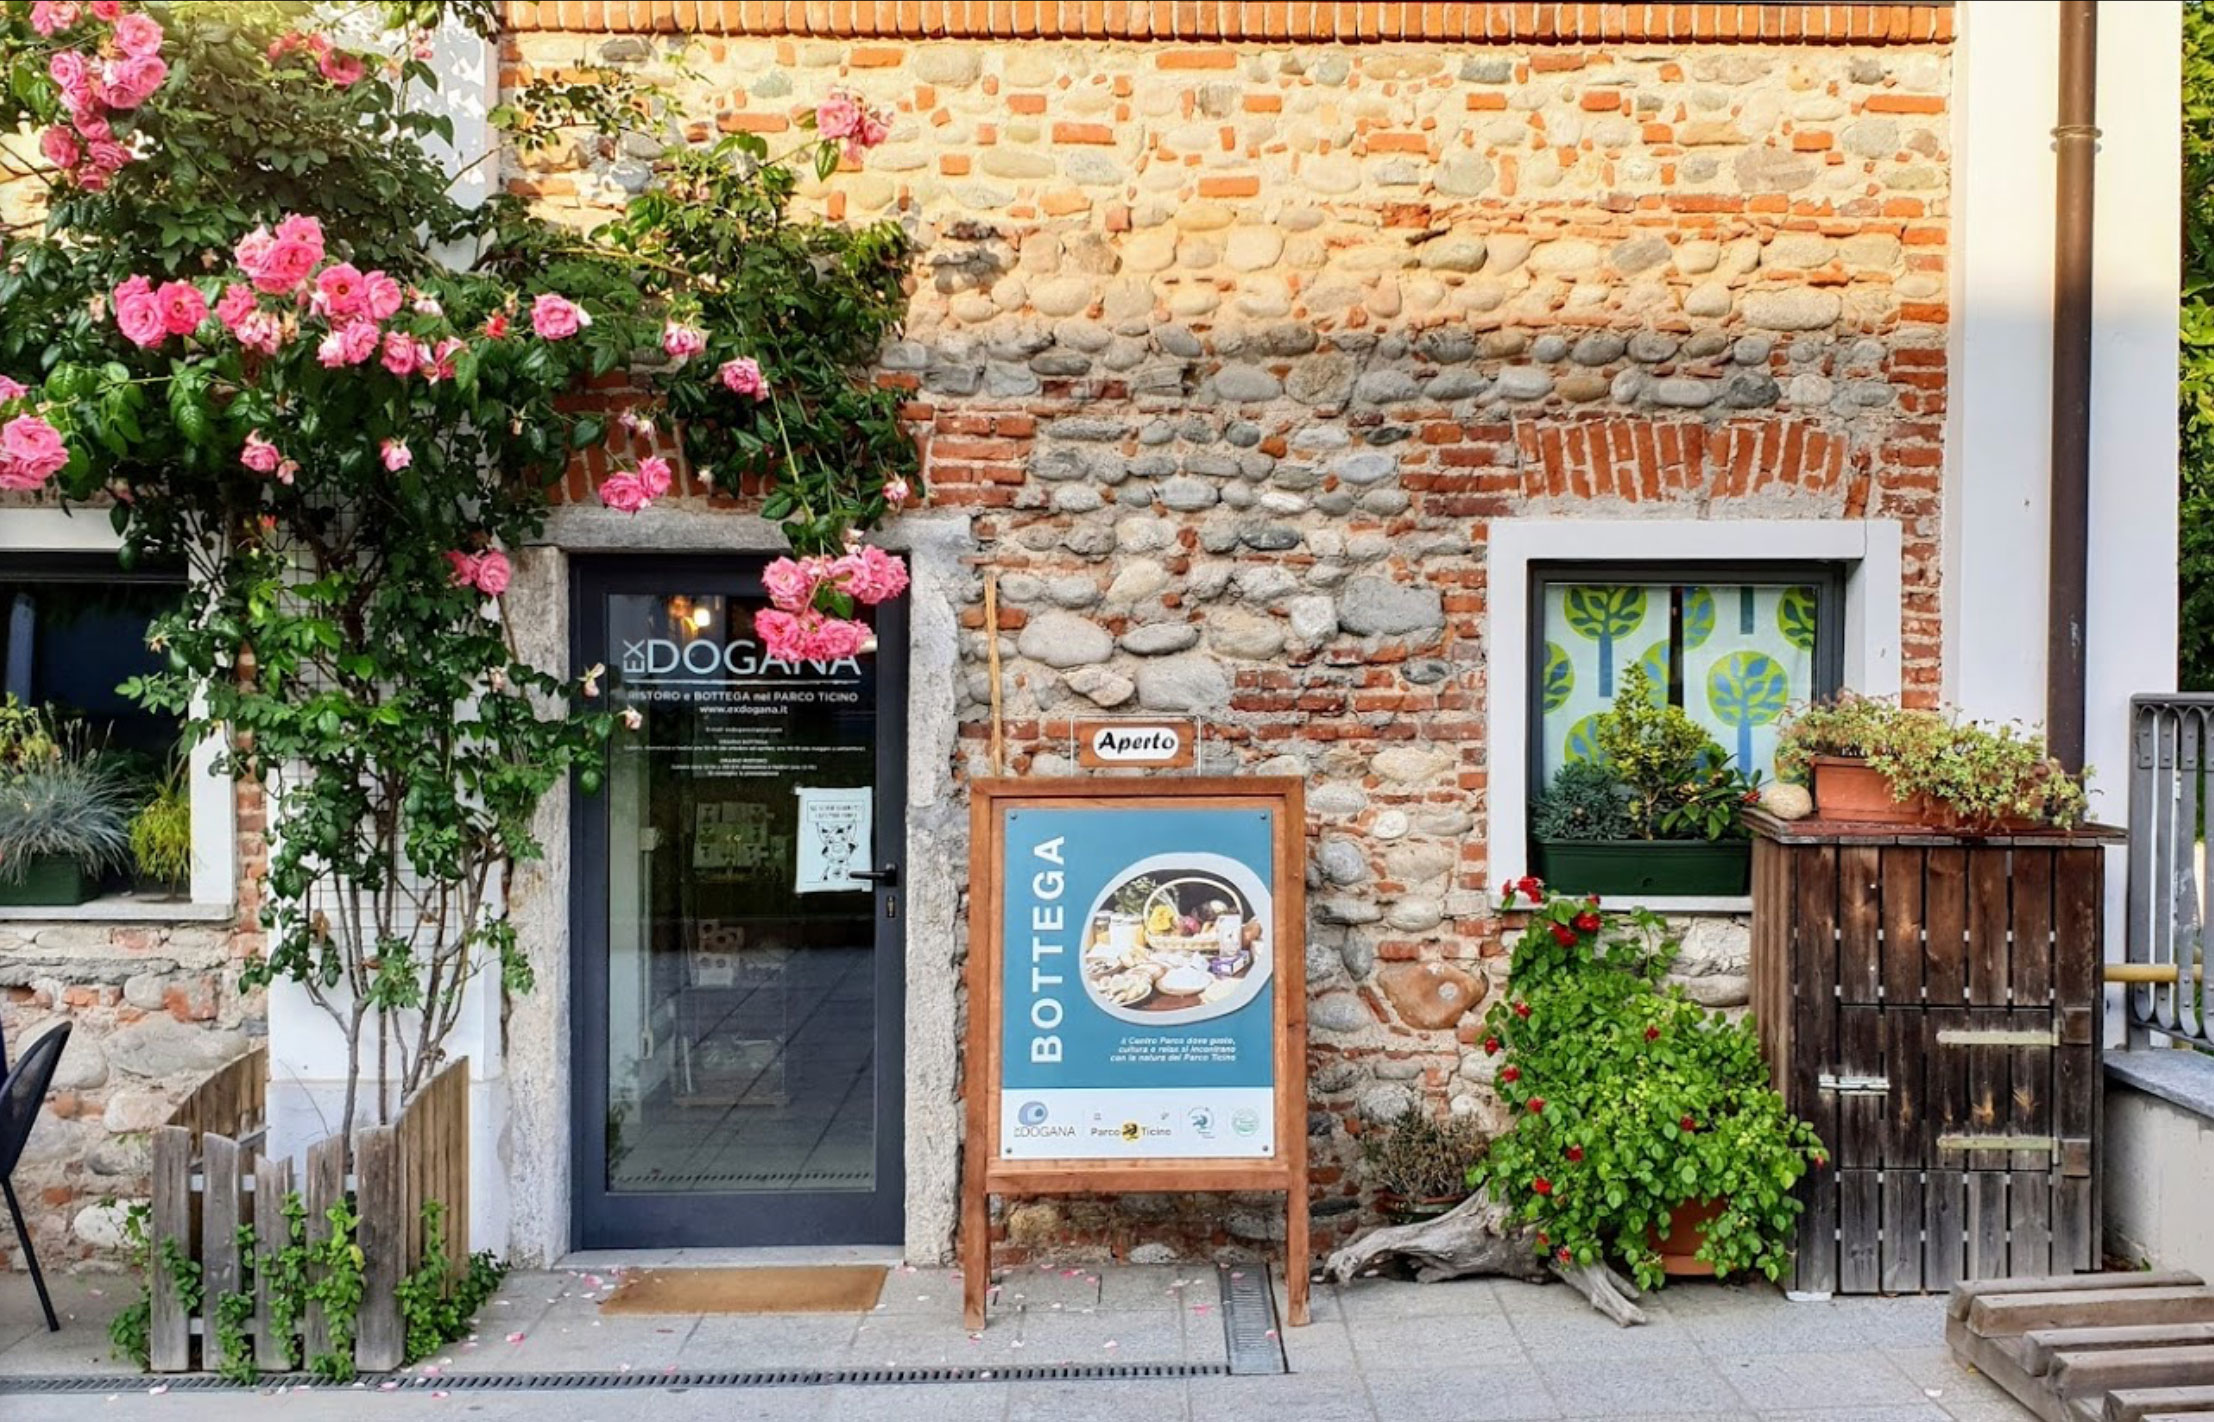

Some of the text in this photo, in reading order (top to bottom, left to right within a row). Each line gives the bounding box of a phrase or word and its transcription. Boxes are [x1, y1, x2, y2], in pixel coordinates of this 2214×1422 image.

[623, 639, 645, 673] EX
[627, 691, 859, 702] RISTORO e BOTTEGA nel PARCO TICINO
[699, 705, 788, 714] www.exdogana.it
[1098, 731, 1175, 754] Aperto
[1031, 836, 1064, 1063] BOTTEGA
[1128, 1037, 1158, 1045] Centro
[1159, 1037, 1185, 1045] Parco
[1186, 1037, 1208, 1045] dove
[1209, 1037, 1236, 1046] gusto,
[1110, 1054, 1236, 1062] con la natura del Parco Ticino
[1021, 1126, 1076, 1138] DOGANA
[1090, 1127, 1172, 1137] Parco Ticino
